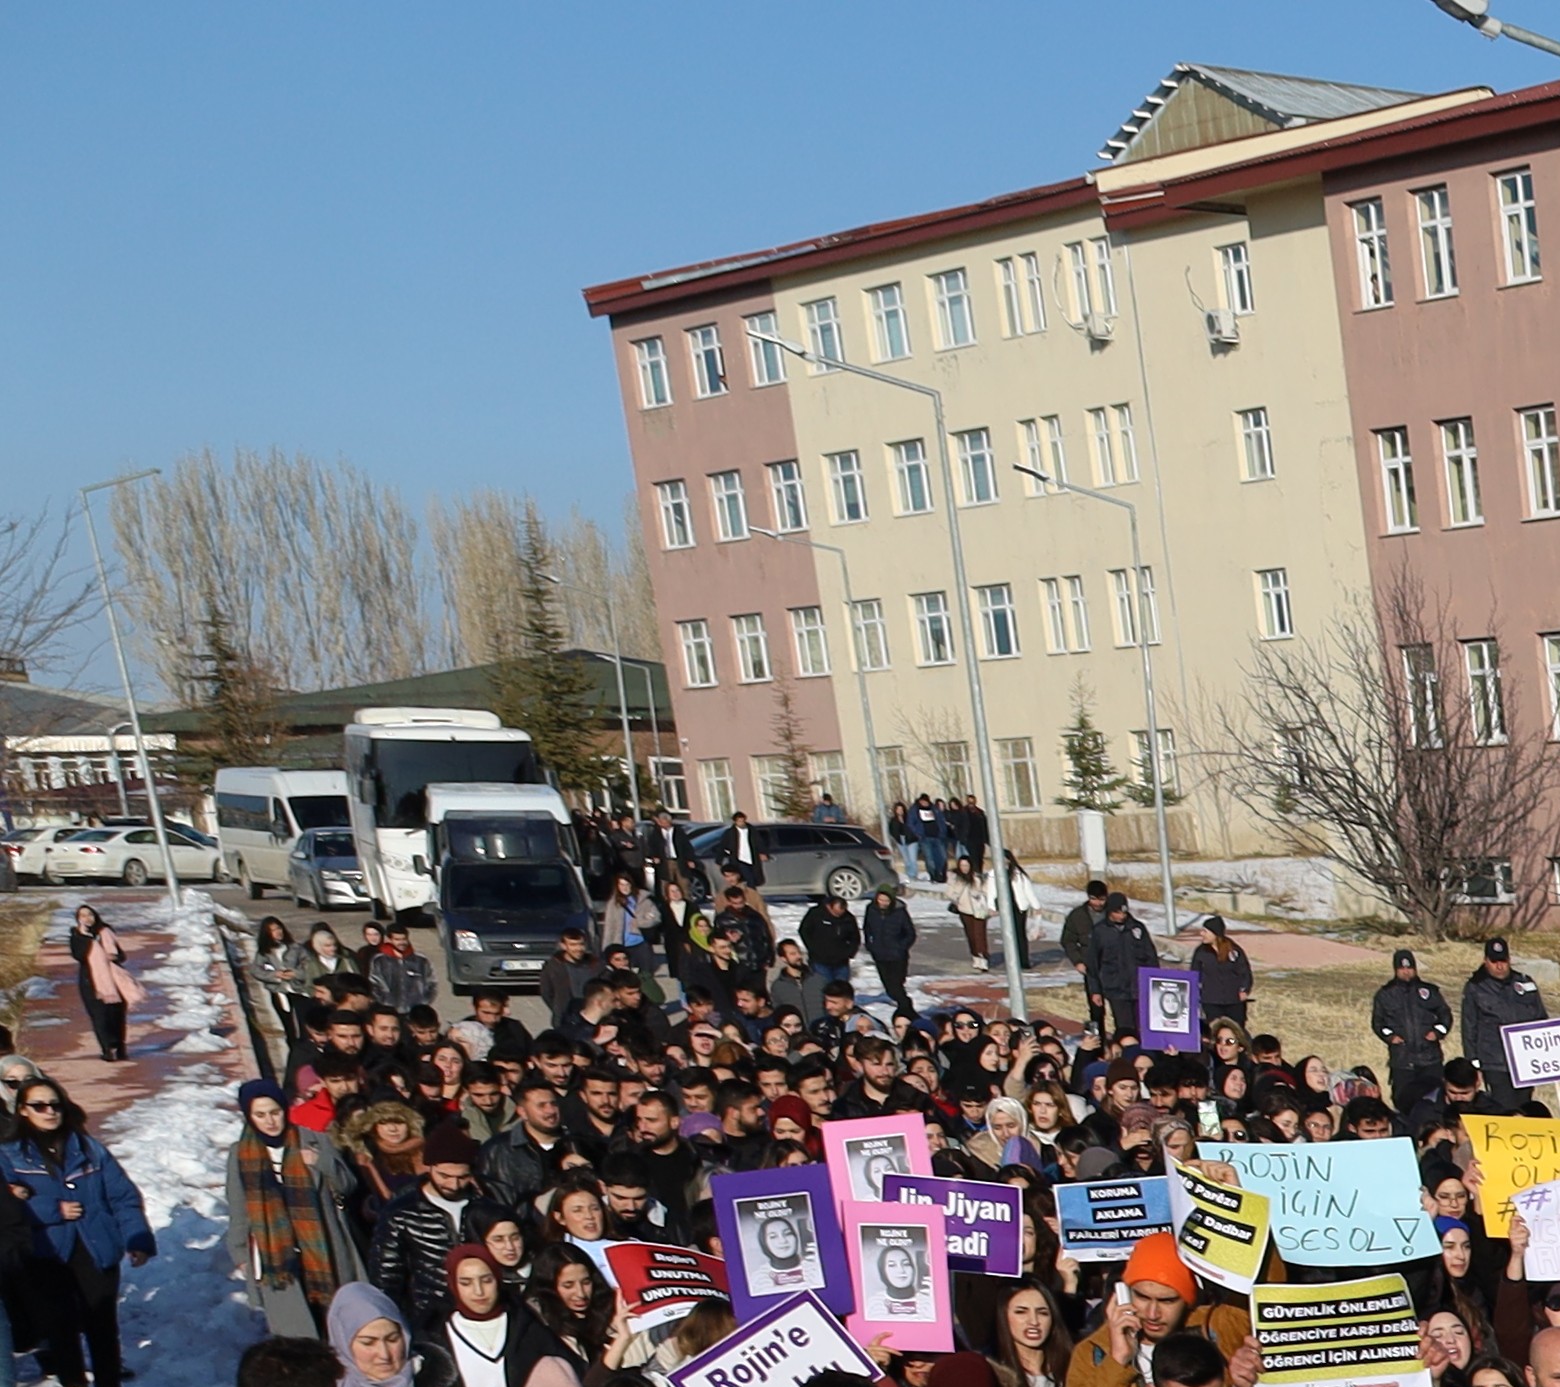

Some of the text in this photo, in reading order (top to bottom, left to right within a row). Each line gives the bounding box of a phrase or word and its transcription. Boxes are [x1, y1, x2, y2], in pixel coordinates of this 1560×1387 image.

[1531, 1058, 1560, 1074] Ses
[1090, 1187, 1139, 1199] KORUNA
[943, 1191, 1012, 1225] Jiyan
[944, 1231, 989, 1257] adî
[650, 1269, 712, 1283] UNUTMA
[1262, 1303, 1337, 1319] GÜVENLİK
[1259, 1325, 1338, 1344] ÖĞRENCİYE
[1339, 1322, 1380, 1337] KARŞI
[1263, 1351, 1327, 1369] ÖĞRENCİ
[1328, 1348, 1358, 1365] İÇİN
